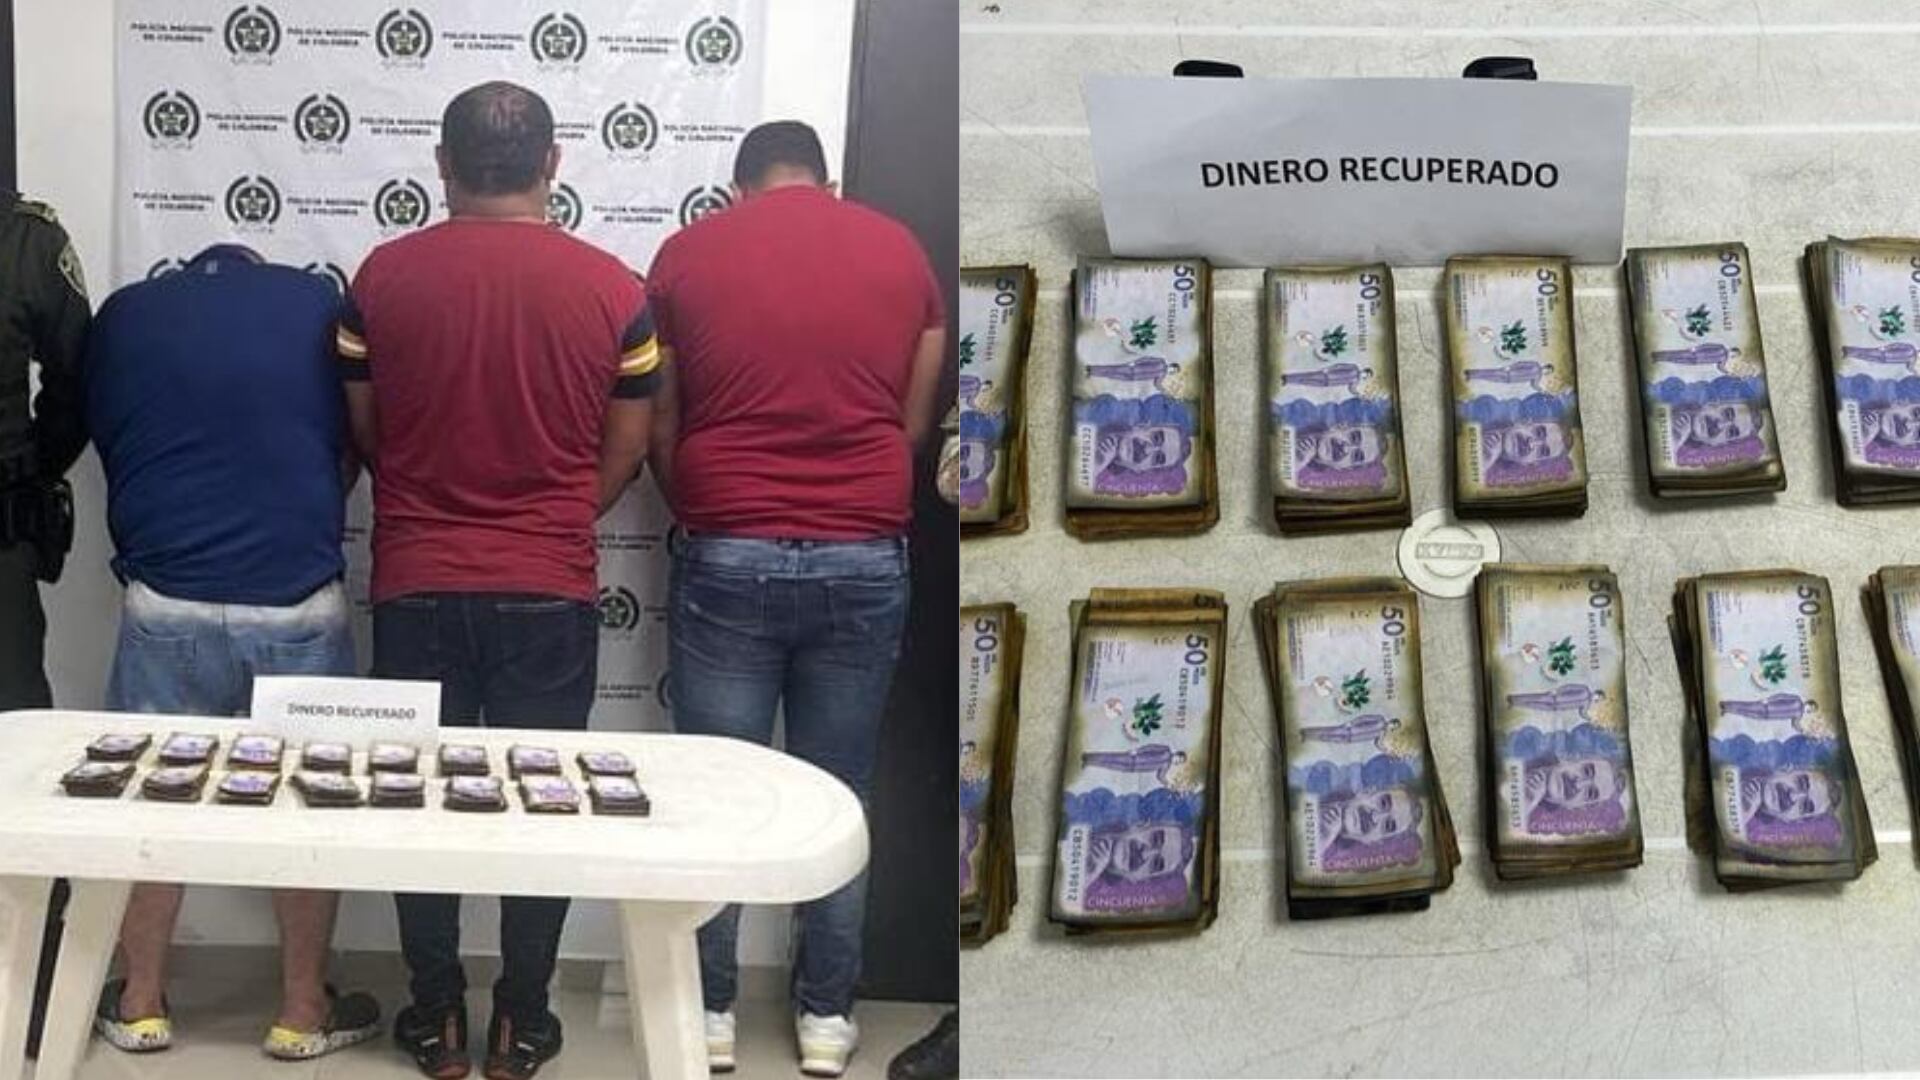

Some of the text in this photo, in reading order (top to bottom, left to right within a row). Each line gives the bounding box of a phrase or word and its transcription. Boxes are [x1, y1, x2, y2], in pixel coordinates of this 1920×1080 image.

[1200, 156, 1559, 189] DINERO RECUPERADO
[1173, 264, 1195, 291] 50
[1718, 252, 1741, 278] 50
[995, 278, 1016, 307] 50
[1360, 273, 1380, 300] 50
[1537, 268, 1558, 296] 50
[1588, 578, 1612, 608] 50
[1797, 584, 1821, 615] 50
[974, 617, 998, 651] 50
[1381, 606, 1405, 637] 50
[1184, 632, 1208, 665] 50
[337, 706, 416, 720] RECUPERADO
